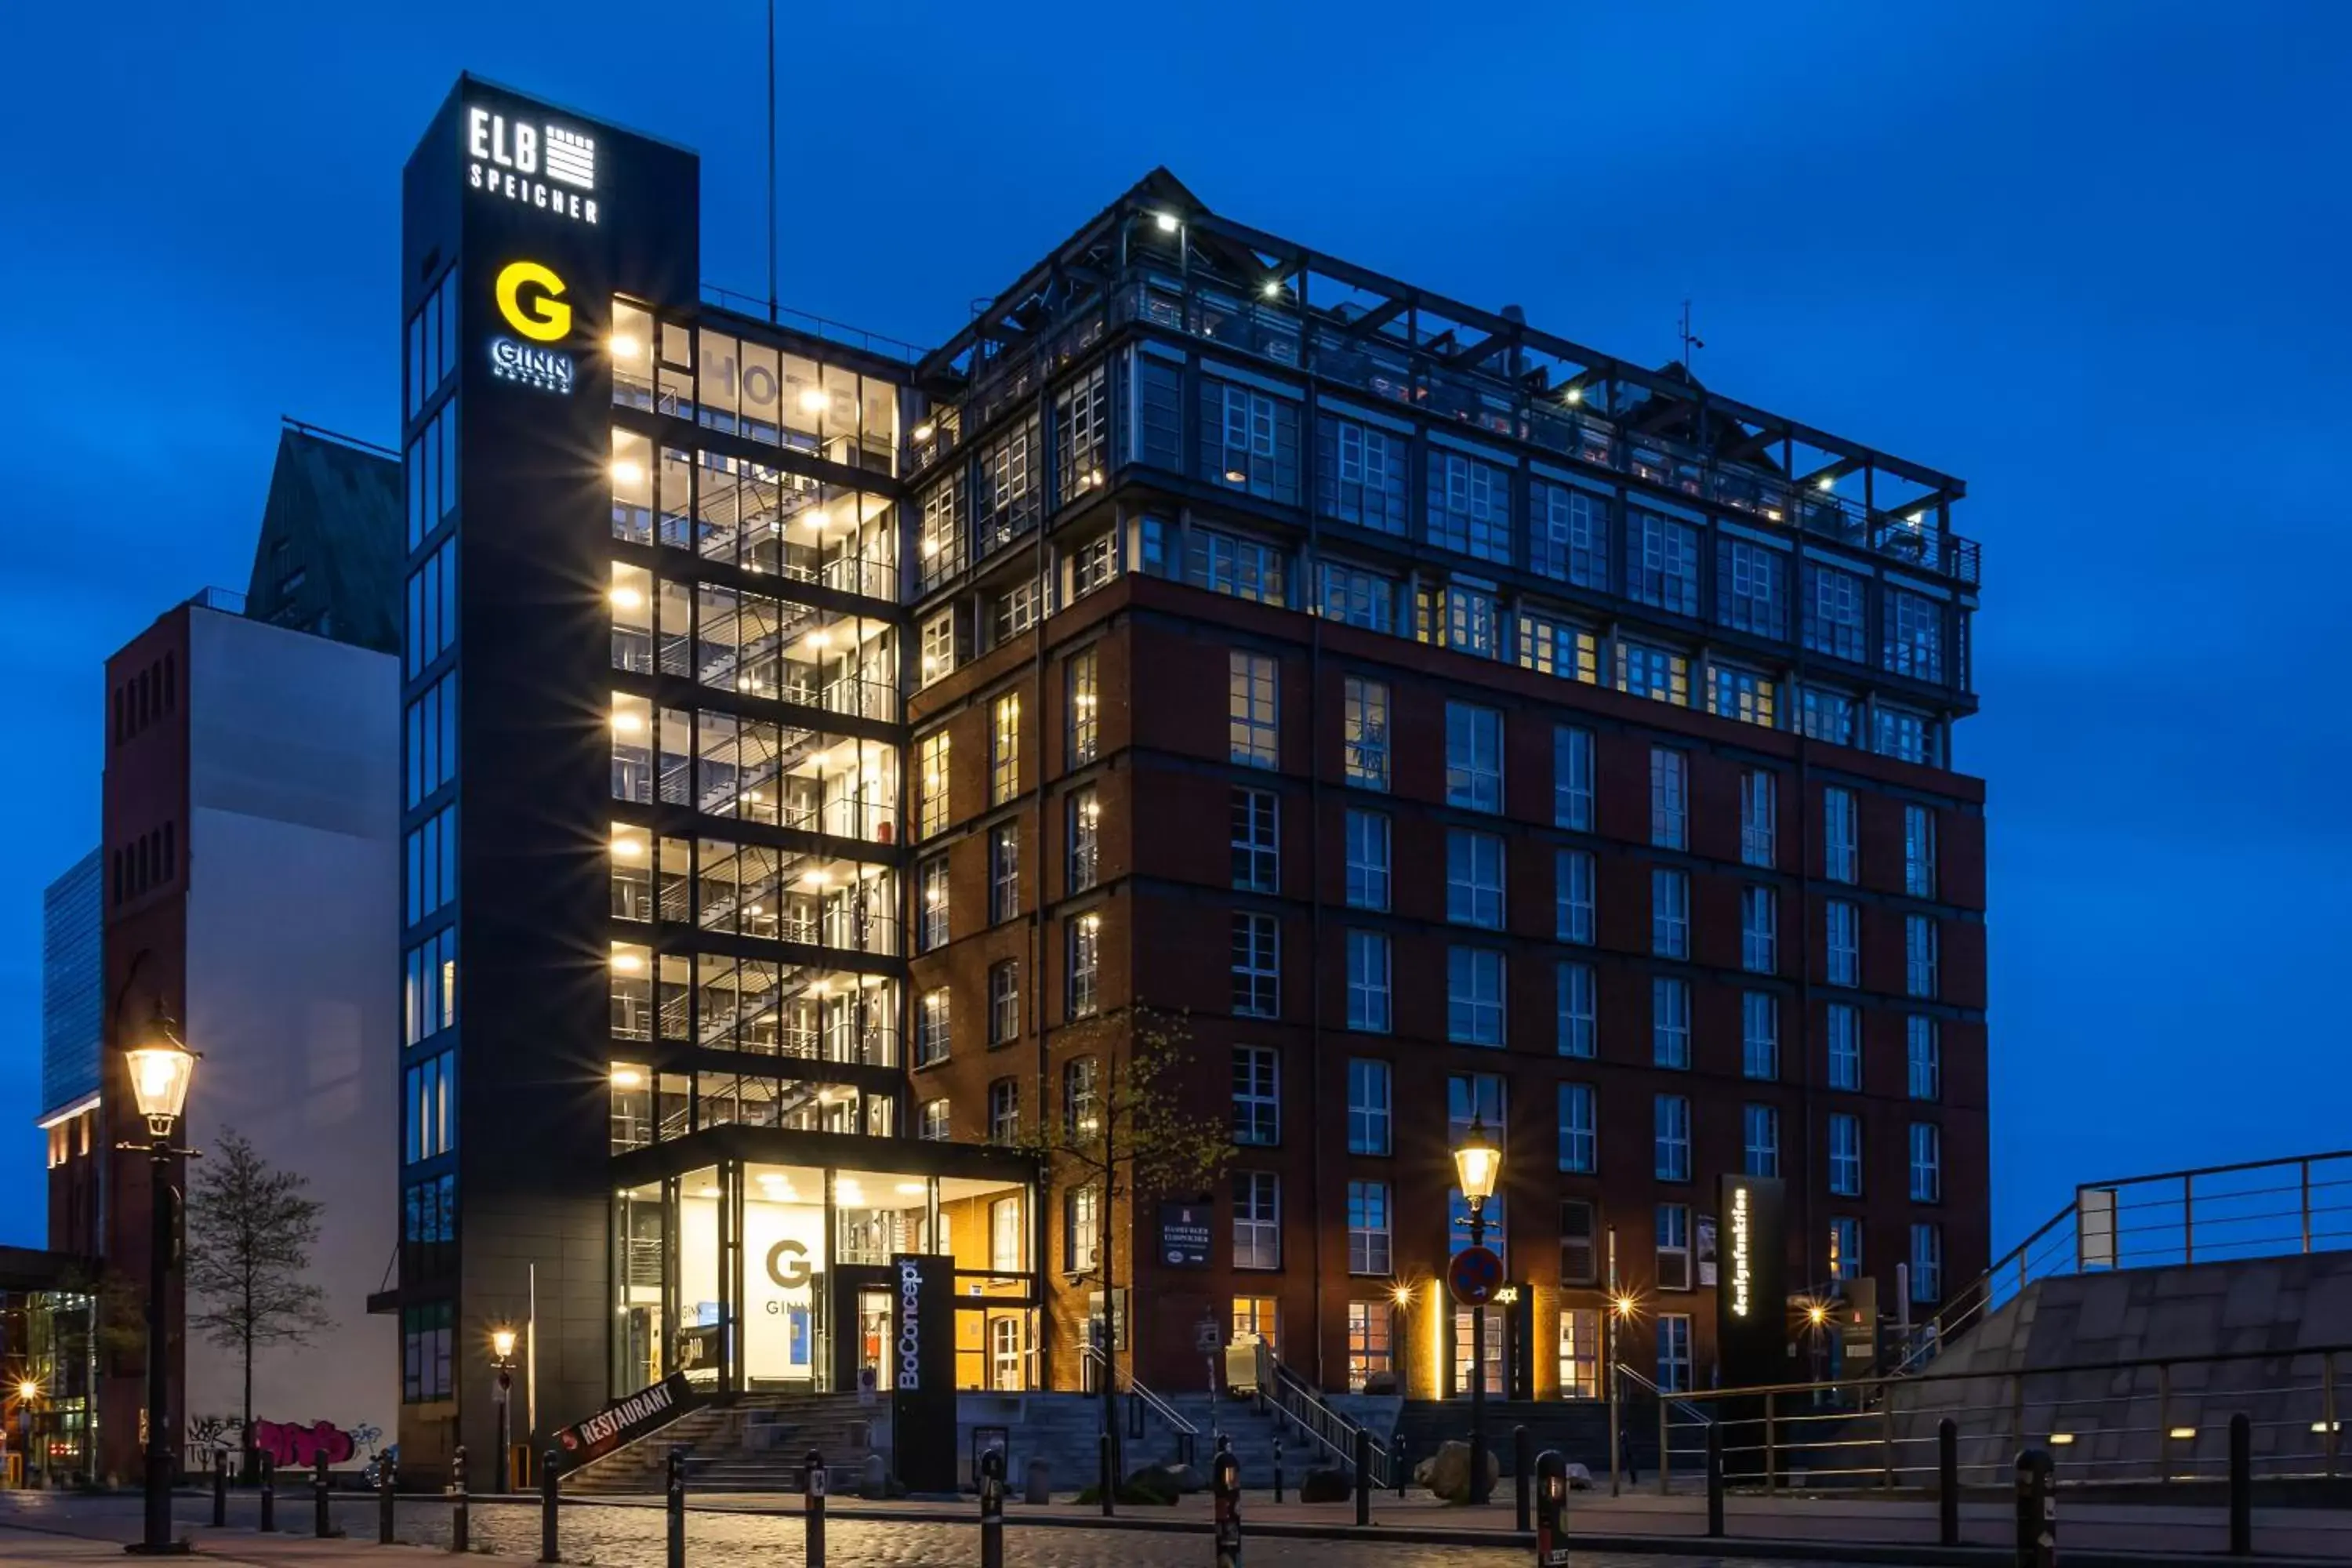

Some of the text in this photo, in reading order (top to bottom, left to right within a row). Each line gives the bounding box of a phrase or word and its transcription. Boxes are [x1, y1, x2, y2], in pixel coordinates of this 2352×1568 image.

[470, 107, 537, 173] ELB
[470, 164, 597, 223] SPEICHER
[496, 262, 572, 341] G
[492, 339, 572, 380] GINN
[766, 1240, 811, 1290] G
[1731, 1188, 1750, 1317] designfunktion
[898, 1258, 924, 1390] BoConcept
[579, 1383, 673, 1446] RESTAURANT
